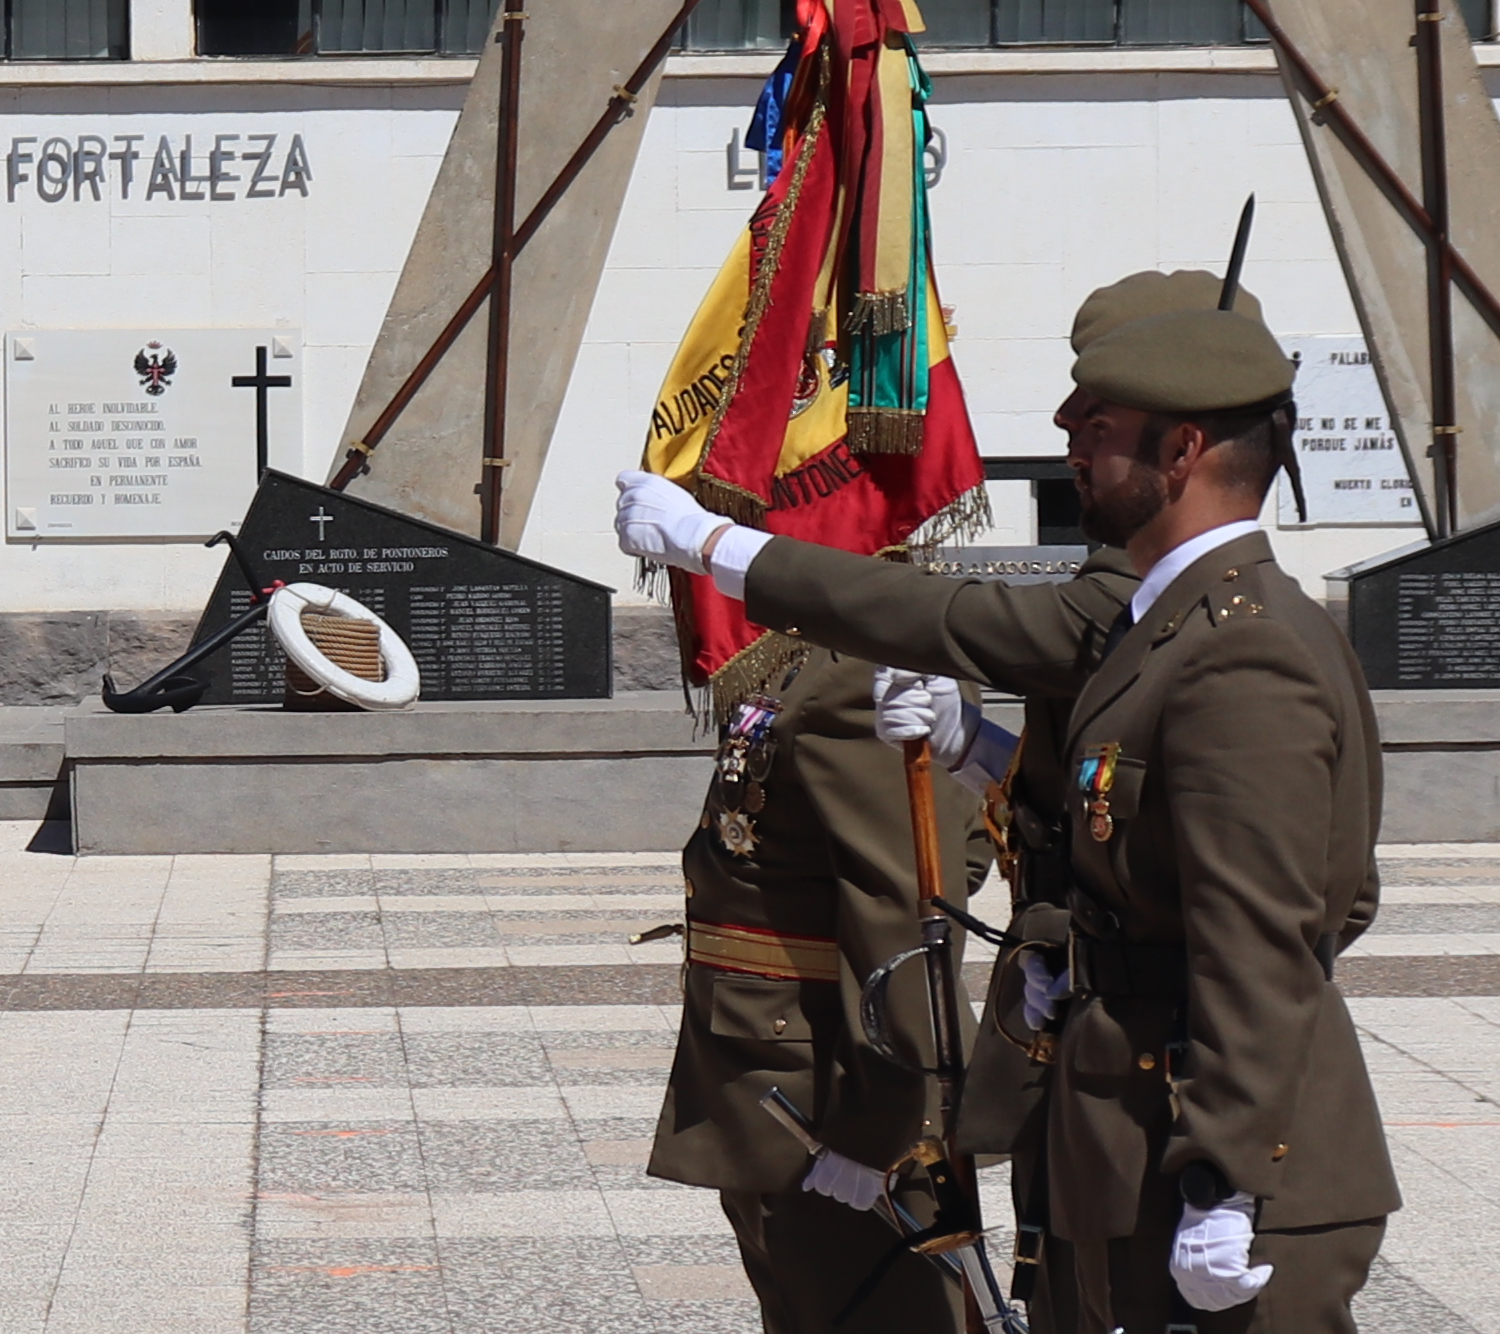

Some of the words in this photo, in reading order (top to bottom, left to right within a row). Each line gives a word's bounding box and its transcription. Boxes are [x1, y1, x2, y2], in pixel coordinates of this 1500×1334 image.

[8, 133, 313, 200] FORTALEZA
[48, 403, 61, 415] AL
[67, 402, 96, 415] HEROE
[48, 421, 61, 433] AL
[67, 420, 104, 433] SOLDADO
[1321, 417, 1335, 430] NO
[1343, 417, 1358, 430] SE
[1364, 417, 1382, 430] ME
[48, 439, 56, 451] A
[62, 438, 84, 450] TODO
[91, 438, 119, 450] AQUEL
[126, 438, 144, 450] QUE
[150, 438, 166, 449] CON
[172, 437, 198, 449] AMOR
[1302, 438, 1347, 451] PORQUE
[98, 456, 110, 468] SU
[117, 456, 138, 468] VIDA
[145, 456, 162, 468] POR
[90, 475, 102, 486] EN
[109, 474, 169, 486] PERMANENTE
[50, 493, 94, 505] RECUERDO
[100, 493, 107, 505] Y
[263, 549, 301, 560] CAIDOS
[305, 549, 326, 560] DEL
[330, 548, 360, 559] RGTO.
[363, 548, 378, 559] DE
[382, 547, 449, 559] PONTONEROS
[299, 563, 314, 574] EN
[318, 562, 345, 574] ACTO
[348, 562, 363, 573] DE
[366, 561, 415, 573] SERVICIO
[968, 562, 983, 576] A
[985, 560, 1043, 575] TODOS
[1046, 560, 1081, 575] LOS
